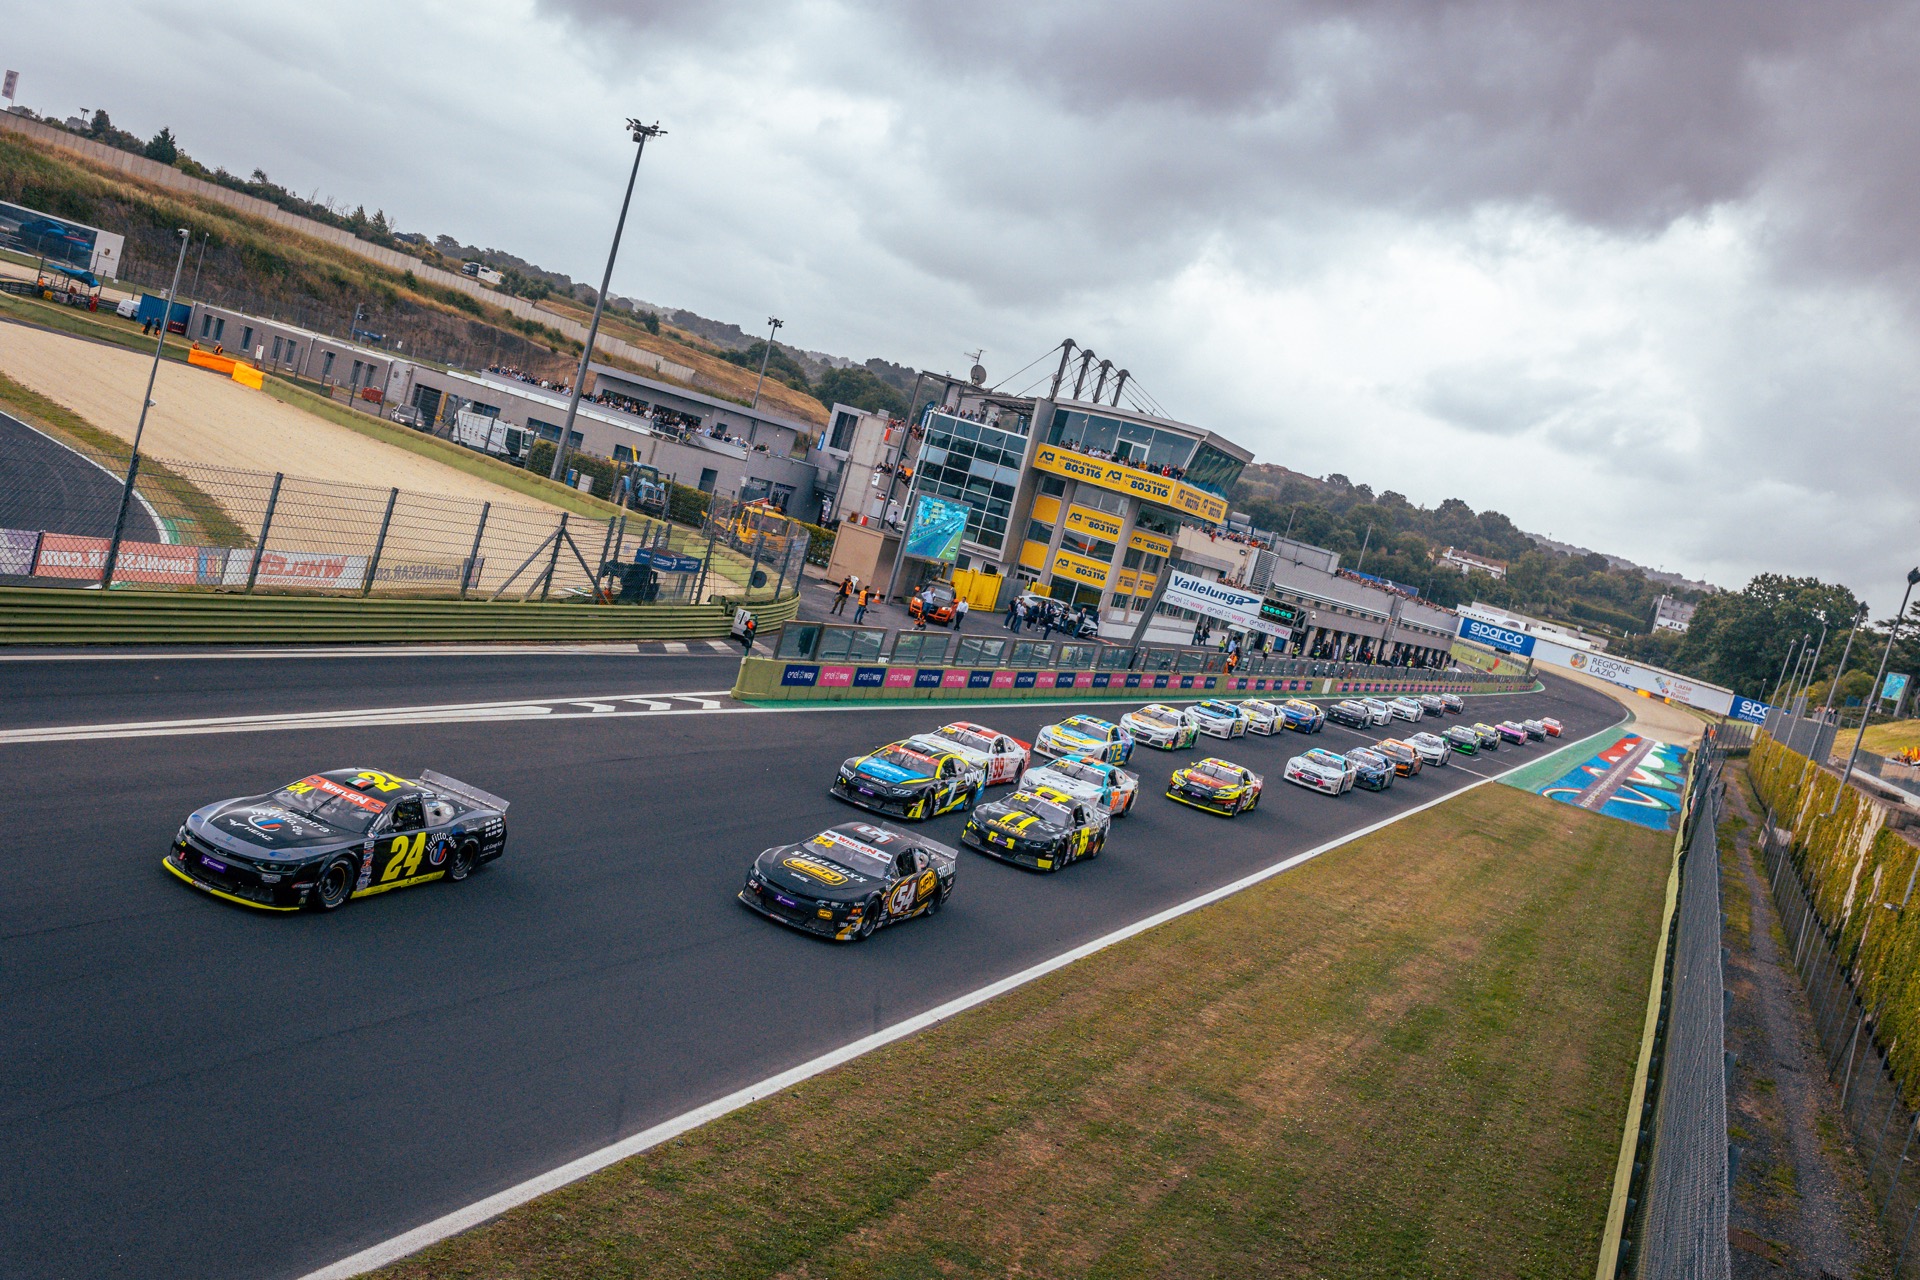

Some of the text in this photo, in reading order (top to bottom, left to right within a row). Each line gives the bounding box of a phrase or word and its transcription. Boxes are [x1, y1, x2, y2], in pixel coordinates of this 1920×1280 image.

[1039, 451, 1055, 462] ACI
[1106, 470, 1122, 481] ACI
[1069, 512, 1082, 521] ACI
[1056, 558, 1069, 567] ACI
[1173, 575, 1245, 606] Vallelunga
[1166, 593, 1183, 604] enel
[1190, 601, 1204, 611] way
[1207, 606, 1224, 617] enel
[1231, 613, 1245, 623] way
[1249, 619, 1266, 630] enel
[1275, 627, 1290, 637] way
[1471, 622, 1523, 645] sparco
[1589, 665, 1617, 679] LAZIO
[1592, 657, 1631, 675] REGIONE
[1109, 743, 1122, 762] 72
[993, 757, 1005, 778] 99
[286, 782, 315, 795] 24
[321, 781, 369, 805] WHELEN
[946, 781, 957, 807] 7
[244, 826, 274, 842] HEINZ
[813, 835, 835, 848] 54
[838, 835, 877, 855] WHELEN
[380, 831, 426, 882] 24
[791, 850, 868, 883] STEELDUXX
[748, 879, 758, 888] 54
[892, 881, 917, 915] 54
